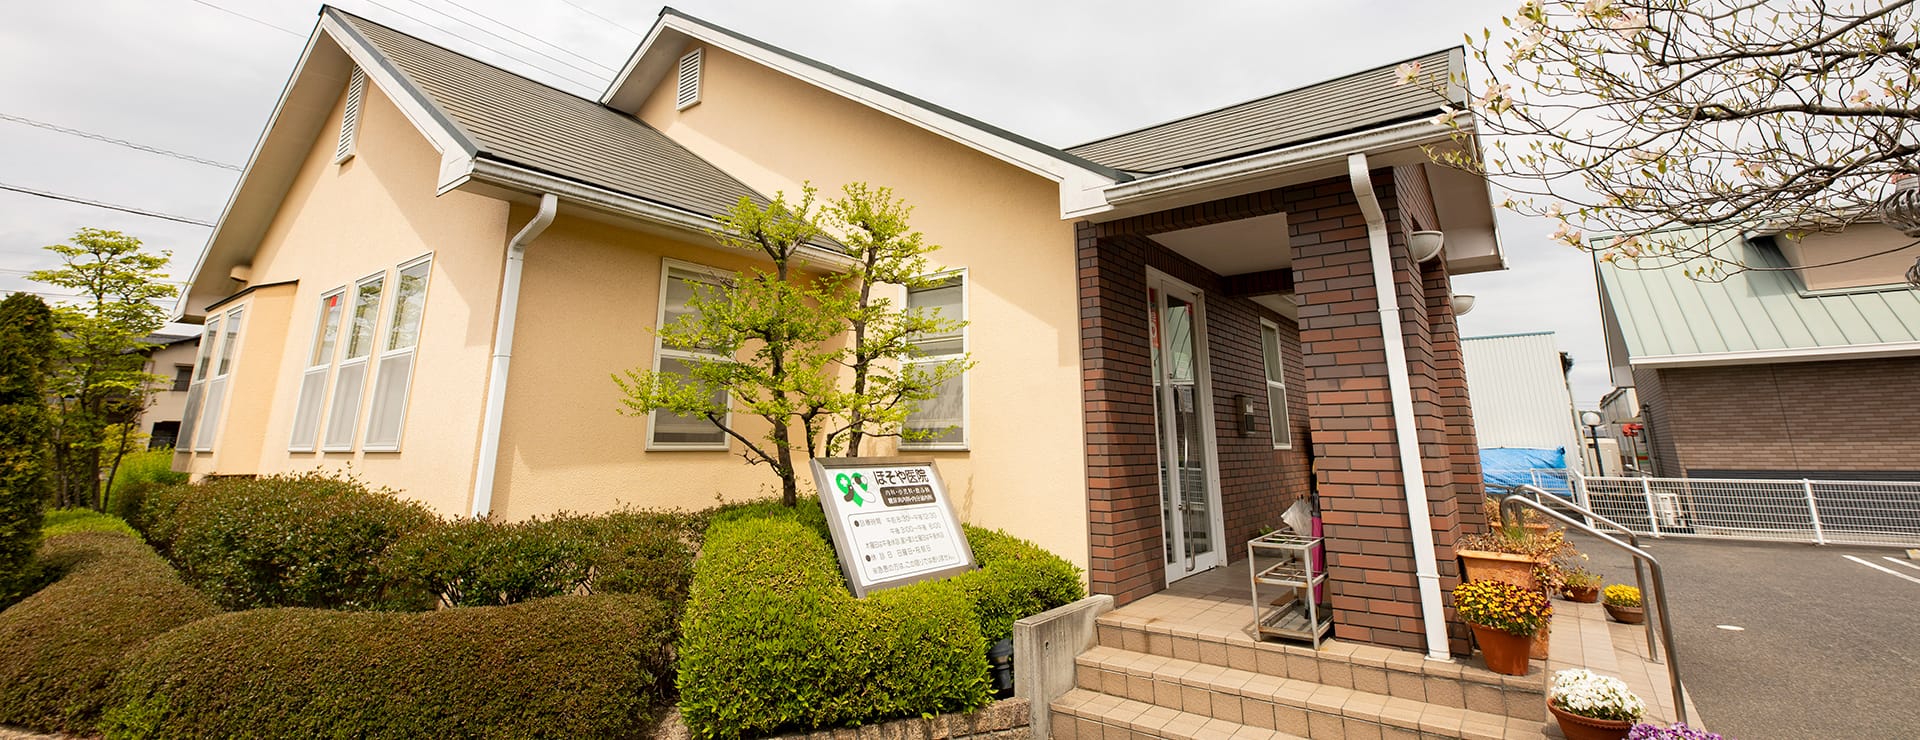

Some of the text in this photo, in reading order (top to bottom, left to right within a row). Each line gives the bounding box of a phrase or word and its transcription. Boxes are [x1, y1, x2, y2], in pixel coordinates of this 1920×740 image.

[873, 468, 929, 485] ほそや医院
